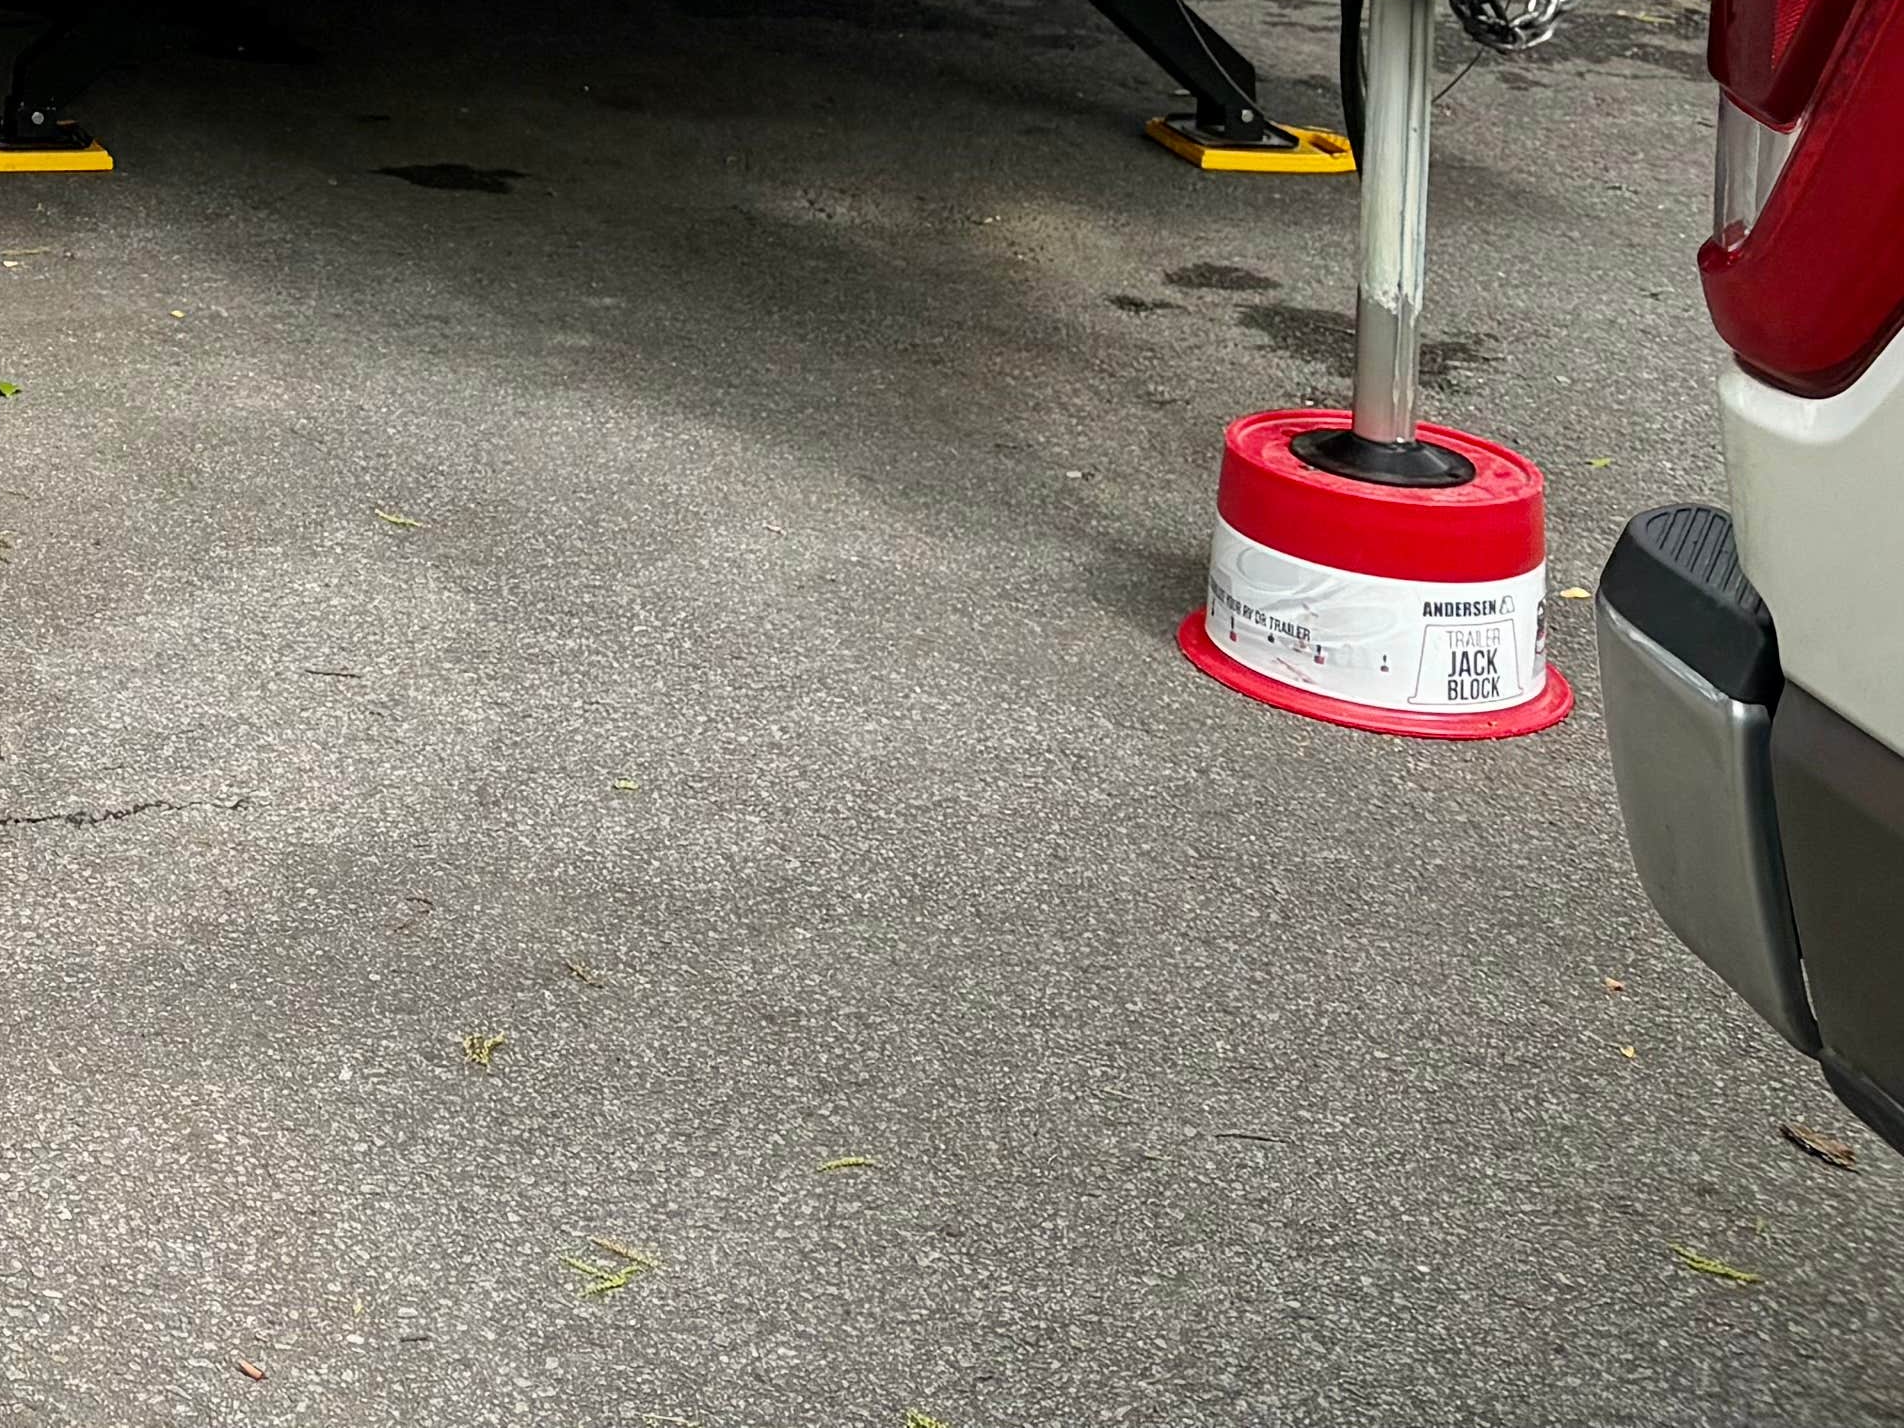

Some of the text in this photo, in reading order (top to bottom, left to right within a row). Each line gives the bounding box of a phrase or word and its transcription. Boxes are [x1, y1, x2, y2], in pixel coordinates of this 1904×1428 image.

[1423, 600, 1496, 617] ANDERSEN
[1269, 616, 1311, 641] TRAILER
[1445, 628, 1501, 649] TRAILER
[1448, 648, 1497, 677] JACK
[1448, 676, 1500, 700] BLOCK
